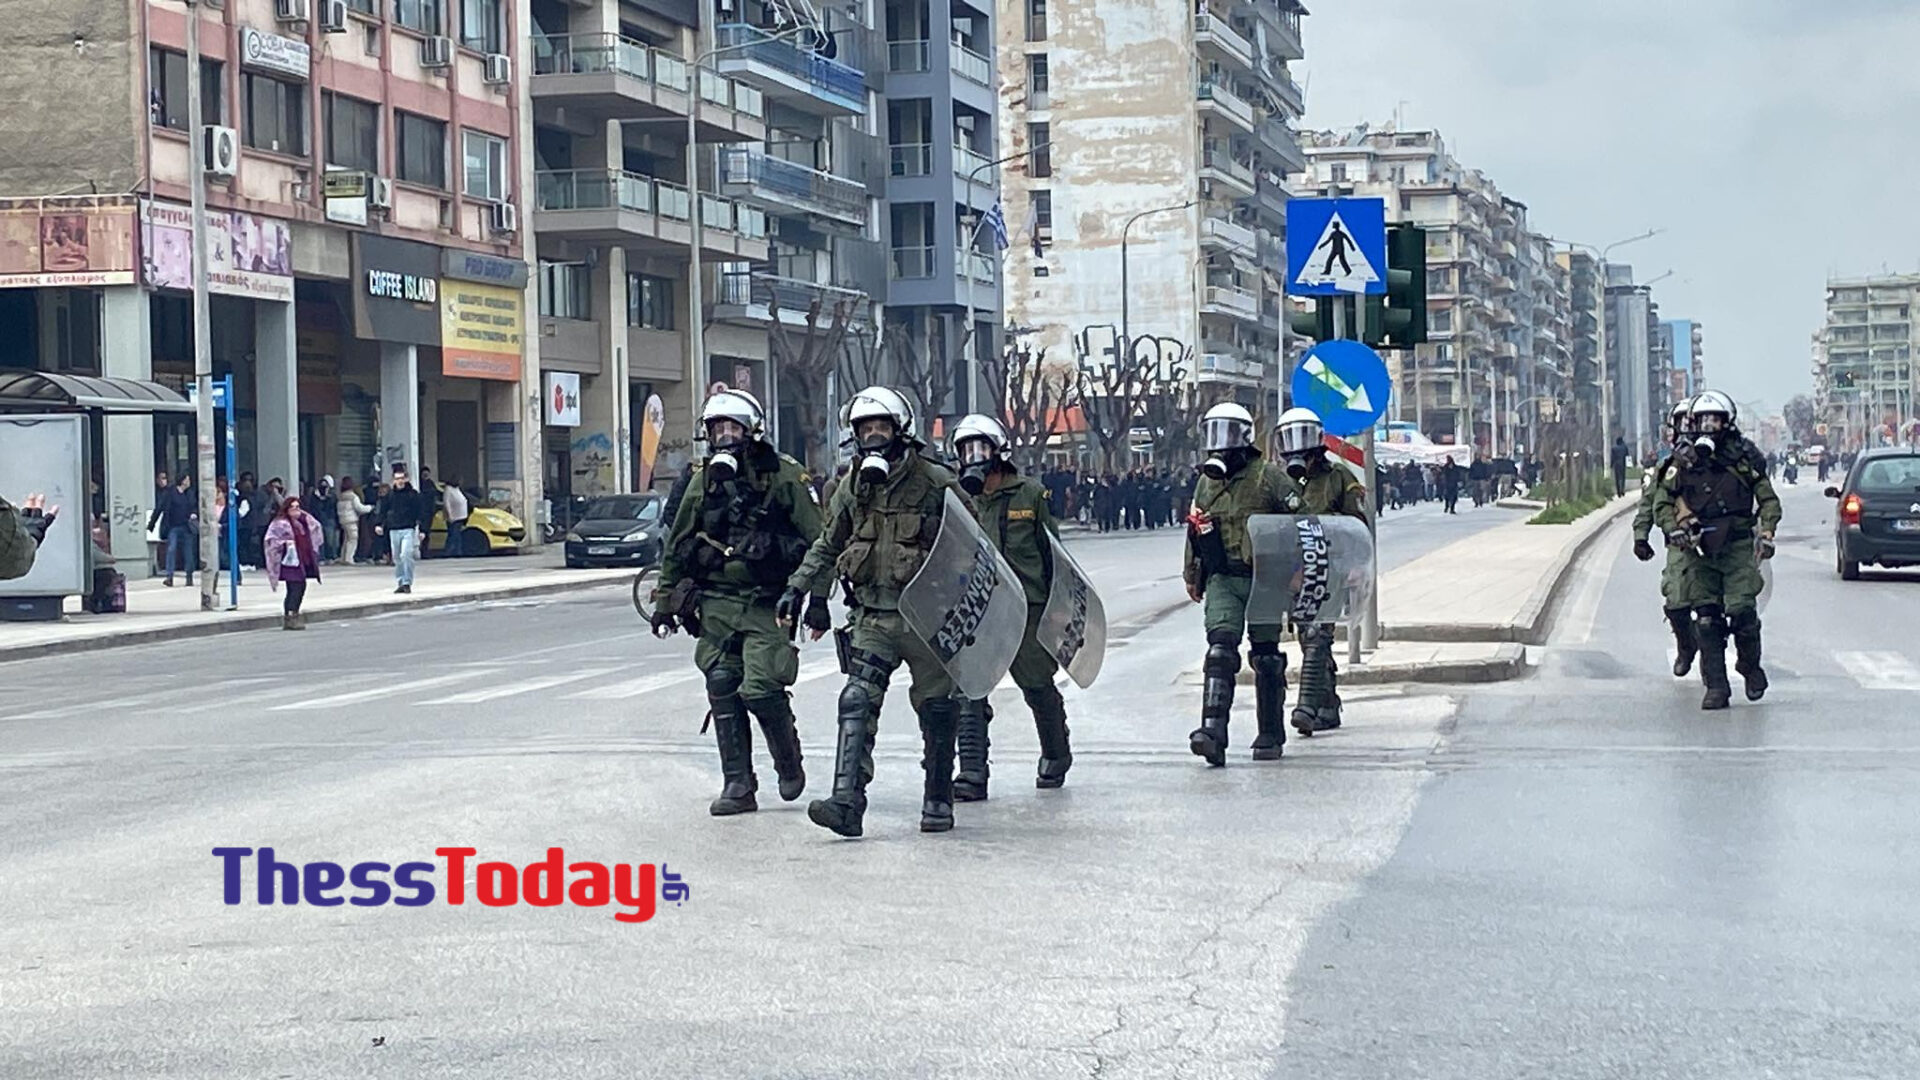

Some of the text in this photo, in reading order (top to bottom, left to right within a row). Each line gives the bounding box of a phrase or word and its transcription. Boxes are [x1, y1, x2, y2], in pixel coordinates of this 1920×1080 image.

[369, 269, 402, 299] COFFEE
[404, 274, 436, 303] ISLAND
[1306, 523, 1328, 616] POLICE
